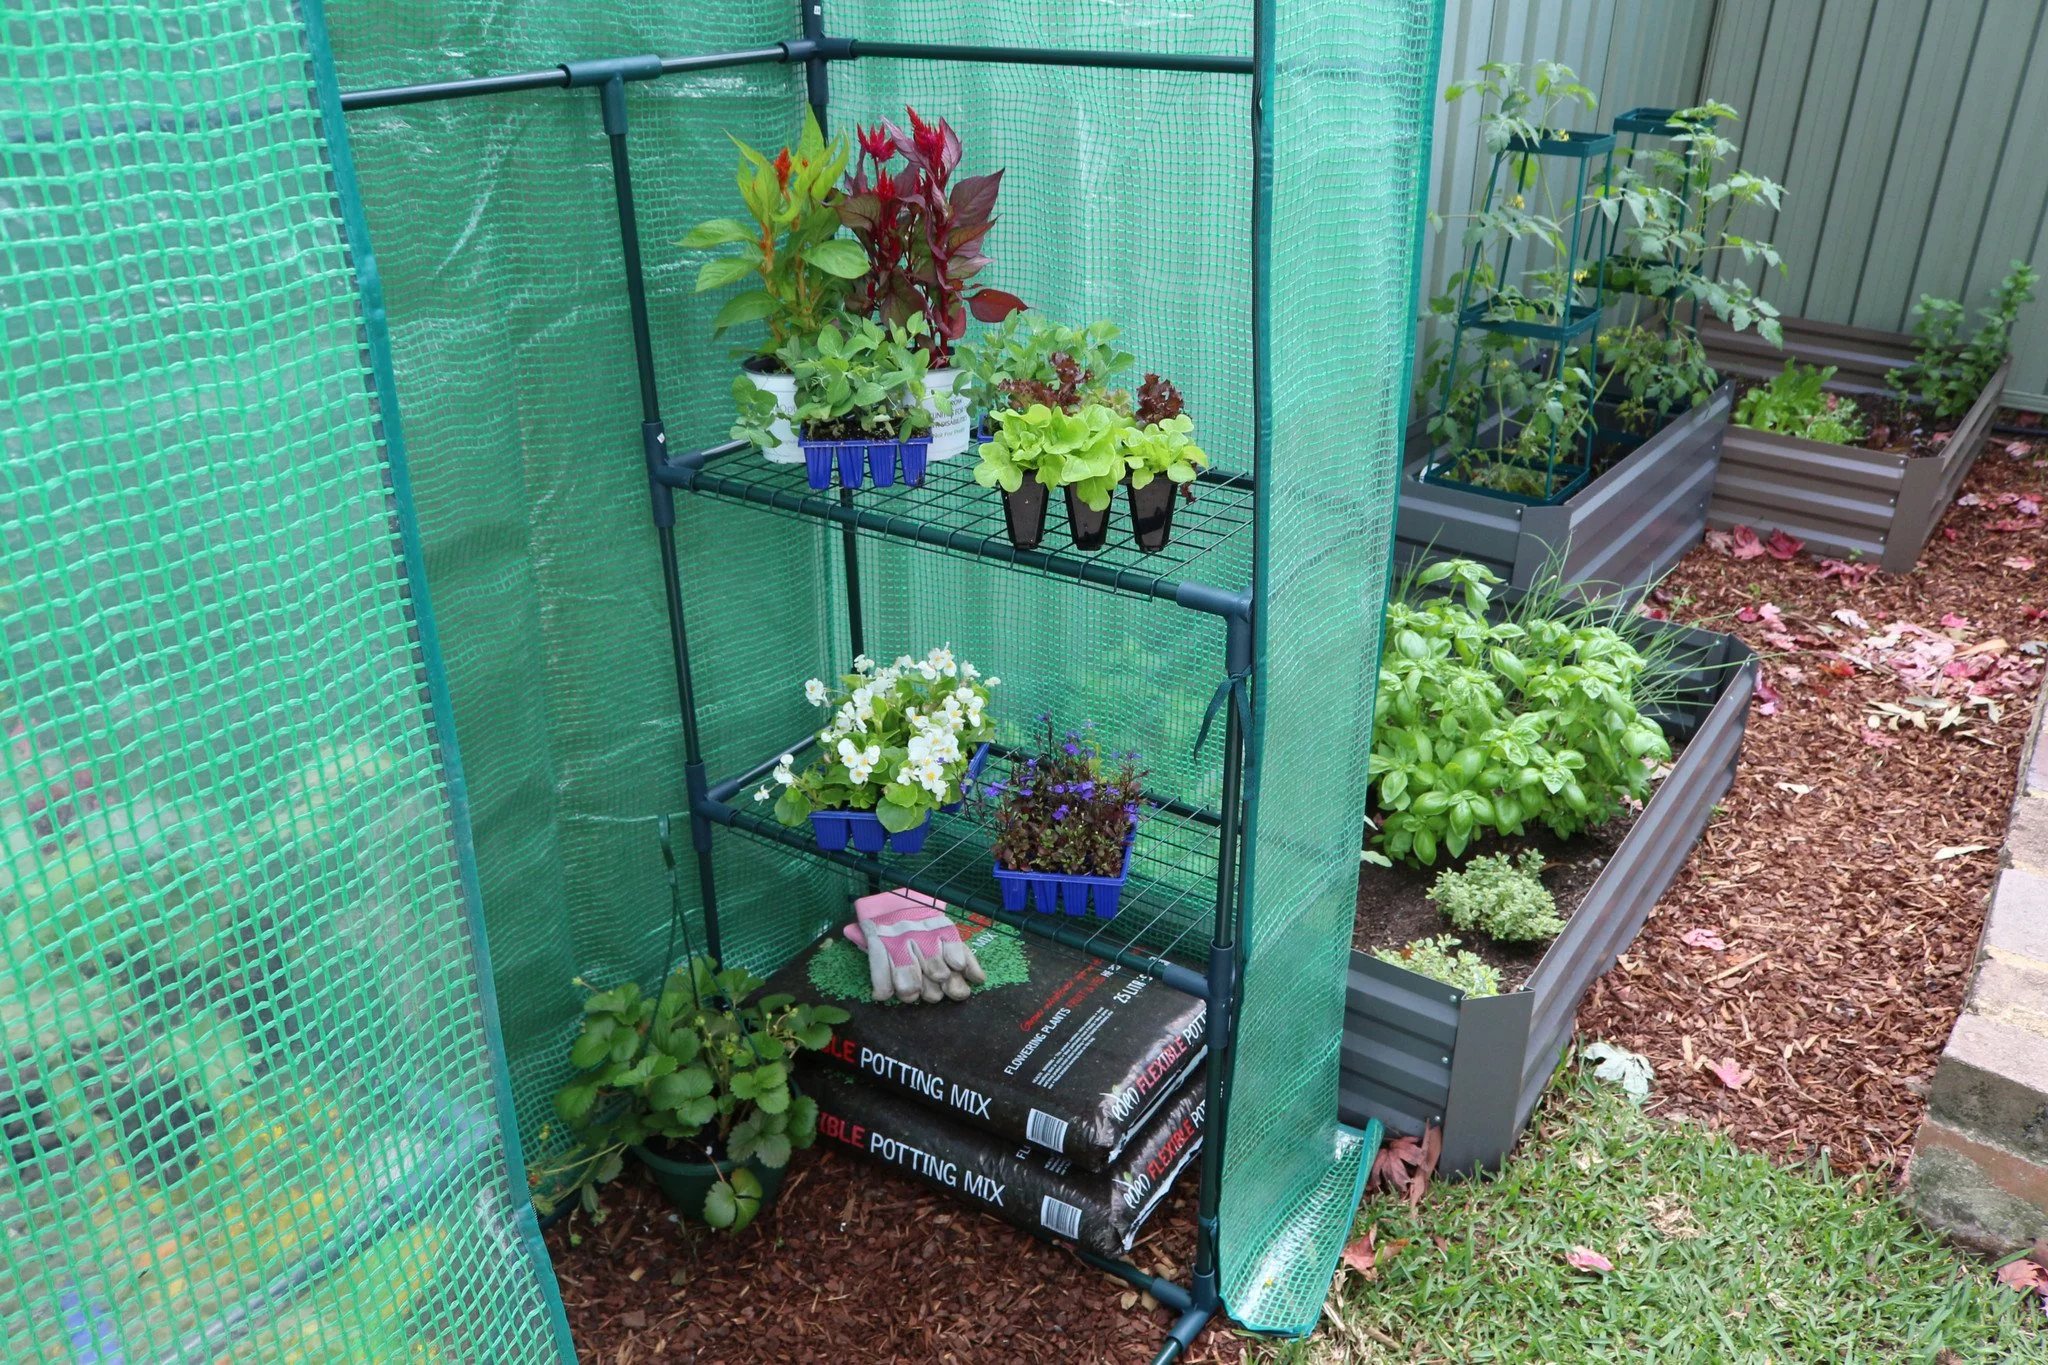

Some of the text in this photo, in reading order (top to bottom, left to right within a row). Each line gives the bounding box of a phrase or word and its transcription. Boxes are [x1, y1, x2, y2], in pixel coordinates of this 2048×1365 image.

[1112, 991, 1131, 1004] 25
[1003, 1028, 1048, 1076] FLOWERING
[1041, 1007, 1072, 1034] PLANTS
[1135, 1035, 1188, 1096] FLEXIBLE
[860, 1046, 944, 1101] POTTING
[950, 1083, 993, 1121] MIX
[870, 1132, 957, 1188] POTTING
[964, 1170, 1006, 1208] MIX
[1145, 1117, 1196, 1181] FLEXIBLE
